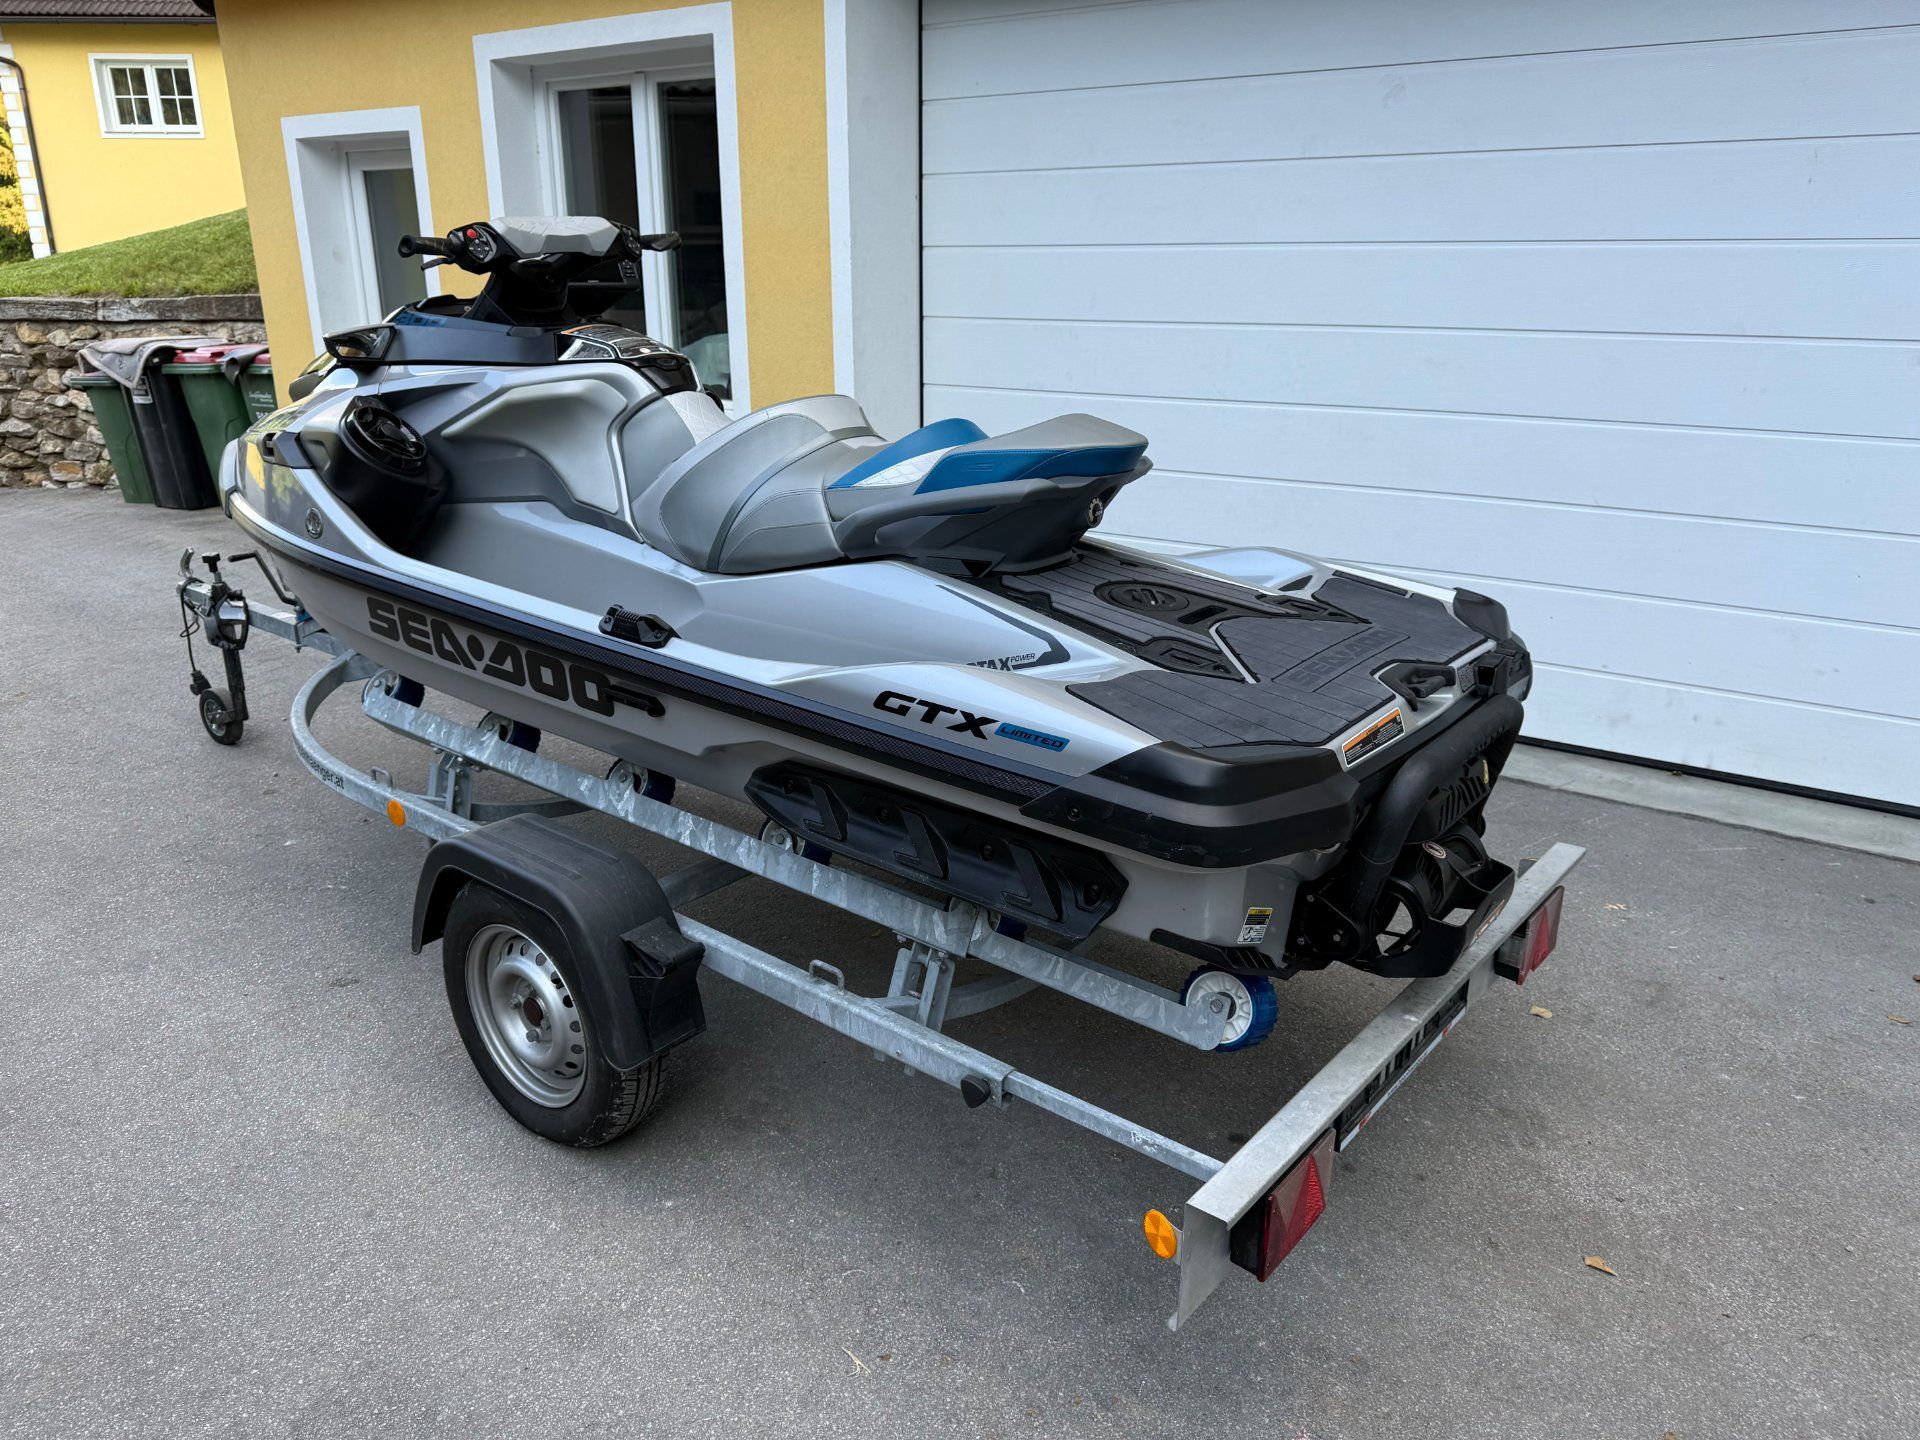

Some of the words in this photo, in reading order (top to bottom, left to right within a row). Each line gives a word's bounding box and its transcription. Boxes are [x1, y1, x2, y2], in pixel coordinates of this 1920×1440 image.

[1010, 653, 1035, 662] POWER
[873, 690, 1000, 740] GTX
[1001, 726, 1064, 748] LIMITED
